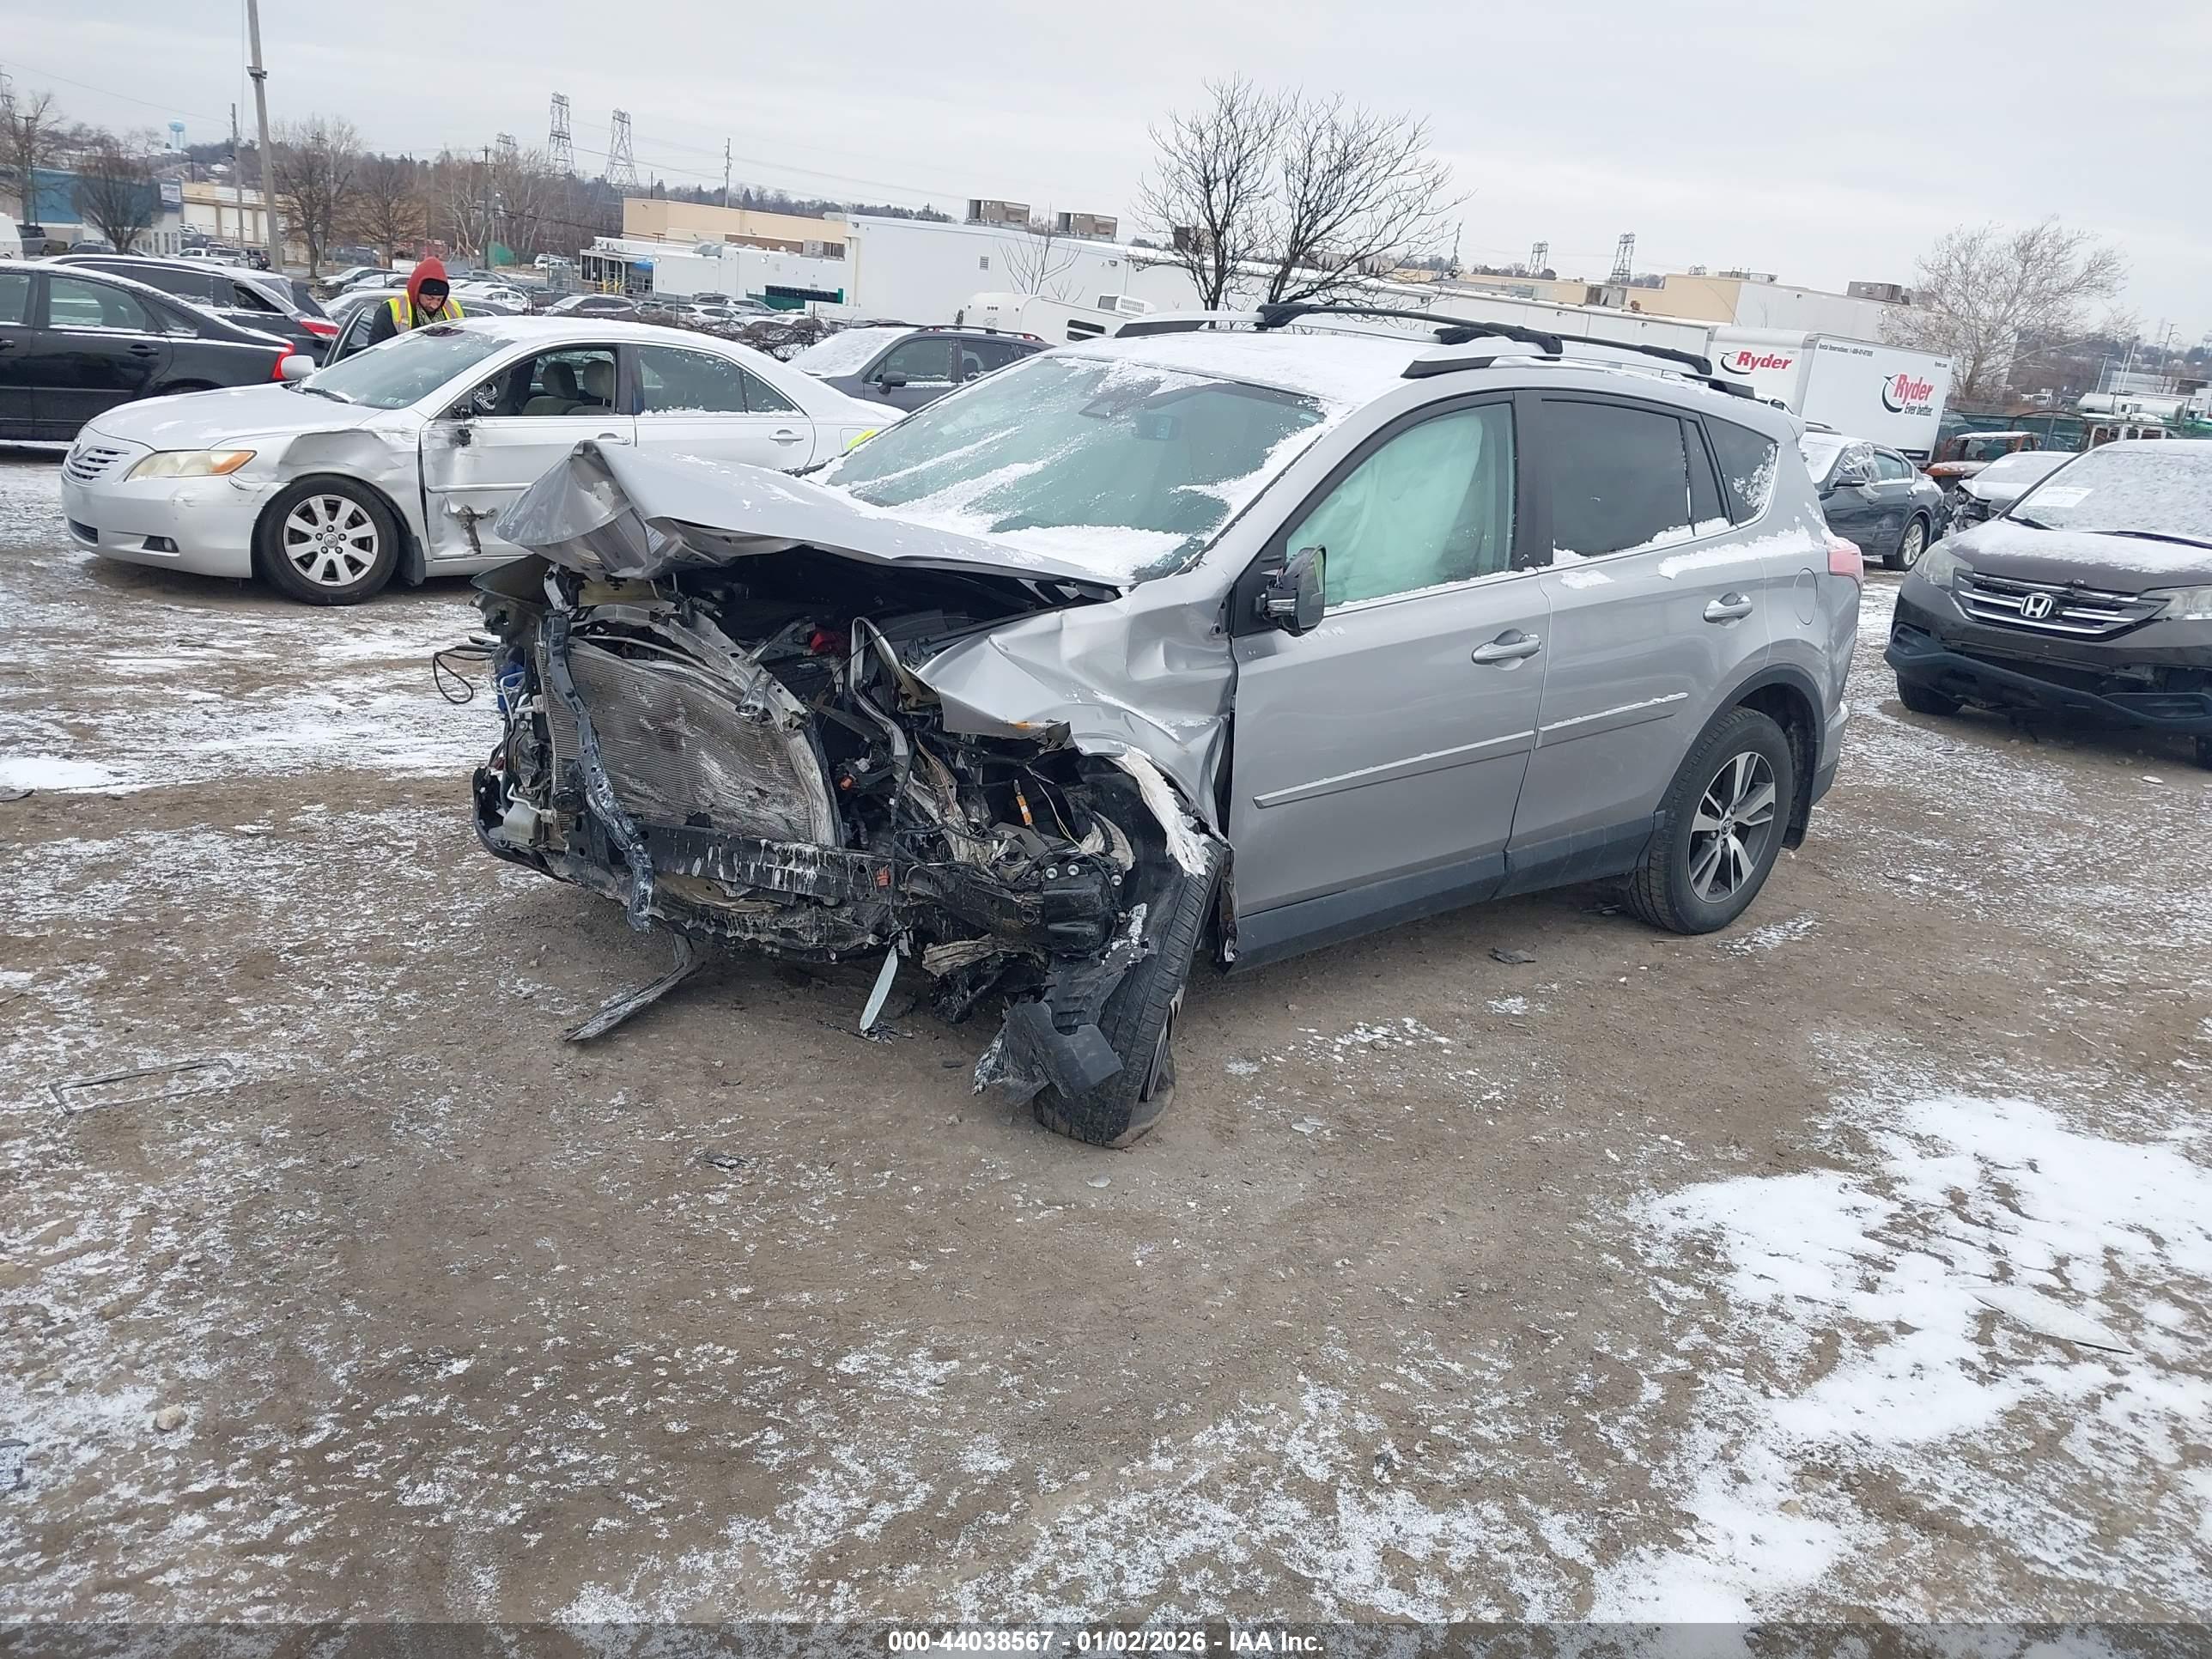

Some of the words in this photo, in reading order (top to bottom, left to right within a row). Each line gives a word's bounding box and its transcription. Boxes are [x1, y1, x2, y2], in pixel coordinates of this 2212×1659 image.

[1736, 350, 1793, 371] Ryder
[1893, 374, 1934, 404] Ryder
[1904, 402, 1917, 415] Ever
[1916, 404, 1934, 416] better
